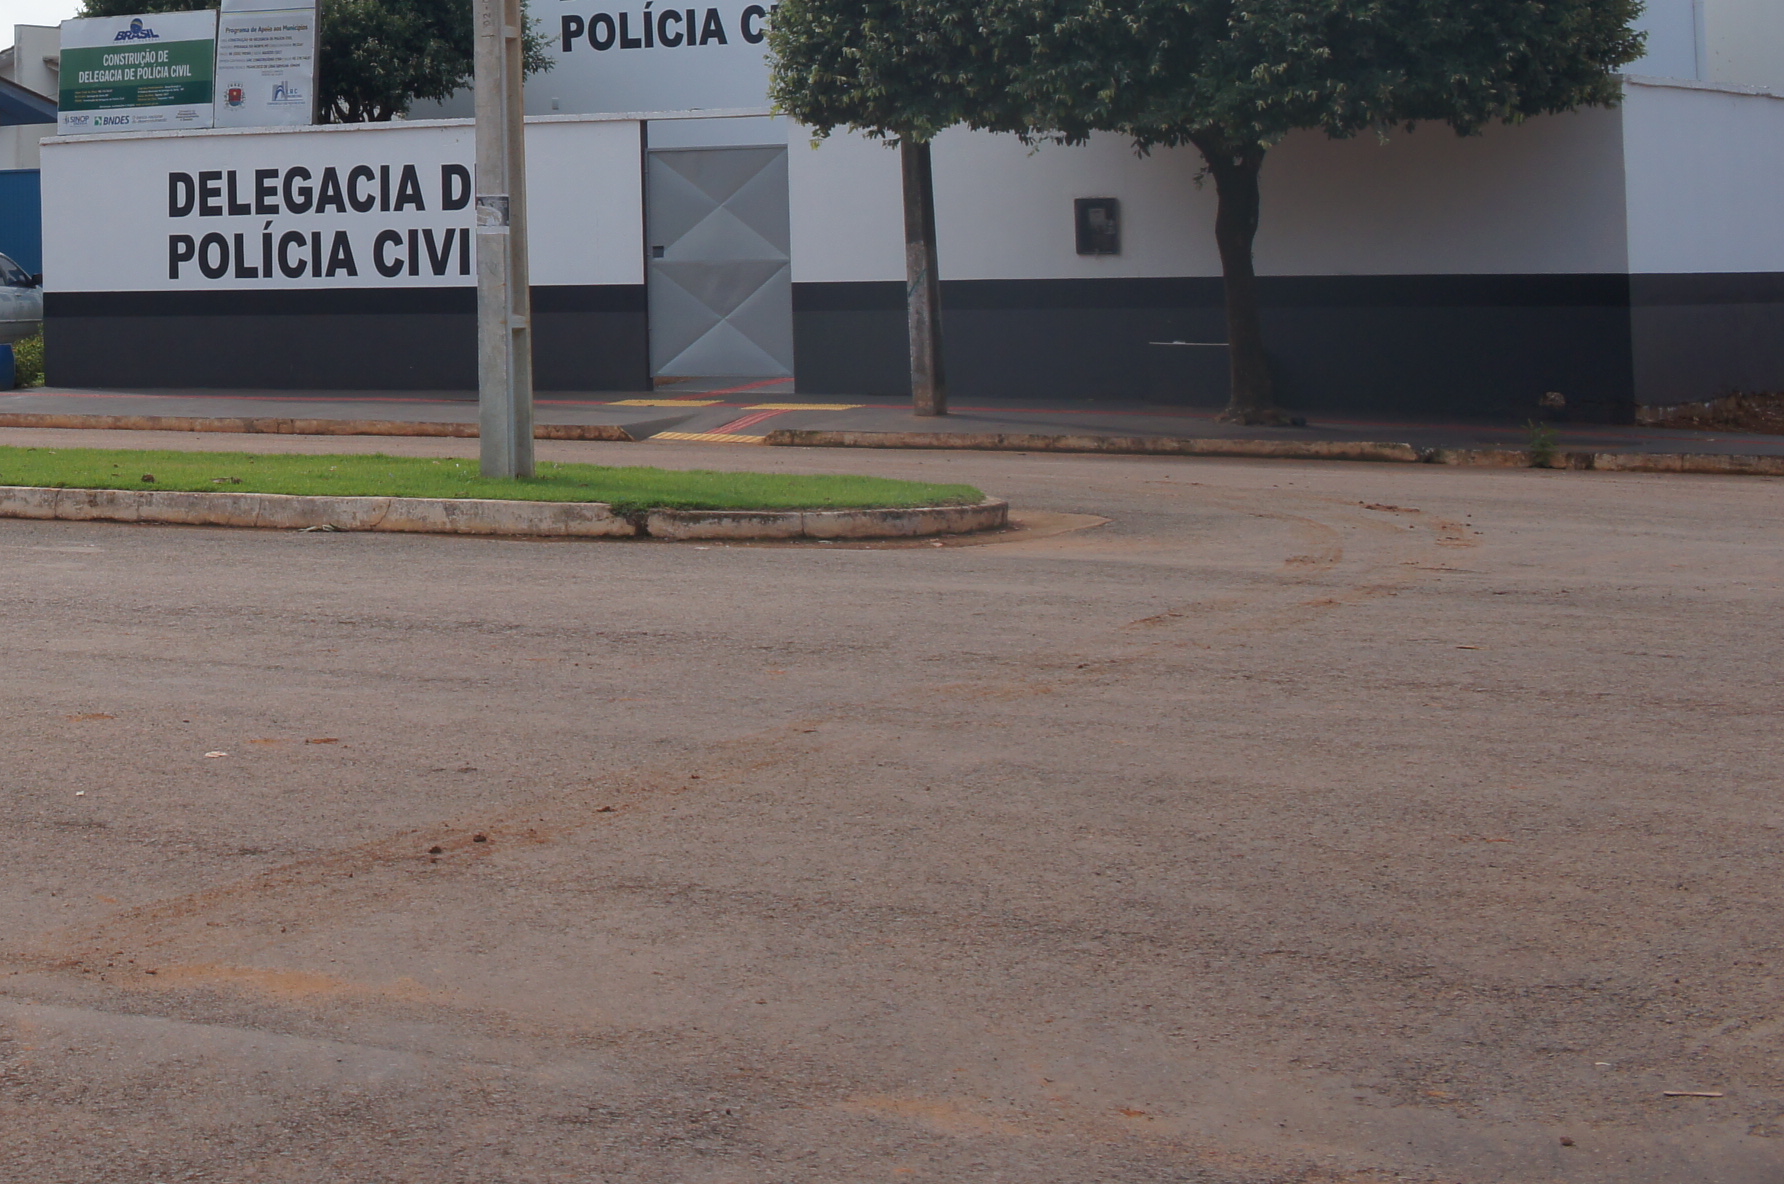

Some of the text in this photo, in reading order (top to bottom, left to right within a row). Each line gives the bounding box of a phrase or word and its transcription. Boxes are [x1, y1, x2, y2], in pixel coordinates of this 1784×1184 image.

[114, 29, 160, 42] BRASIL
[561, 0, 728, 53] POLÍCIA
[103, 49, 169, 67] CONSTRUÇÃO DE
[78, 63, 192, 84] DELEGACIA DE POLÍCIA CIVIL
[103, 115, 130, 126] BNDES
[168, 163, 478, 218] DELEGACIA D
[168, 220, 478, 280] POLÍCIA CIVI
